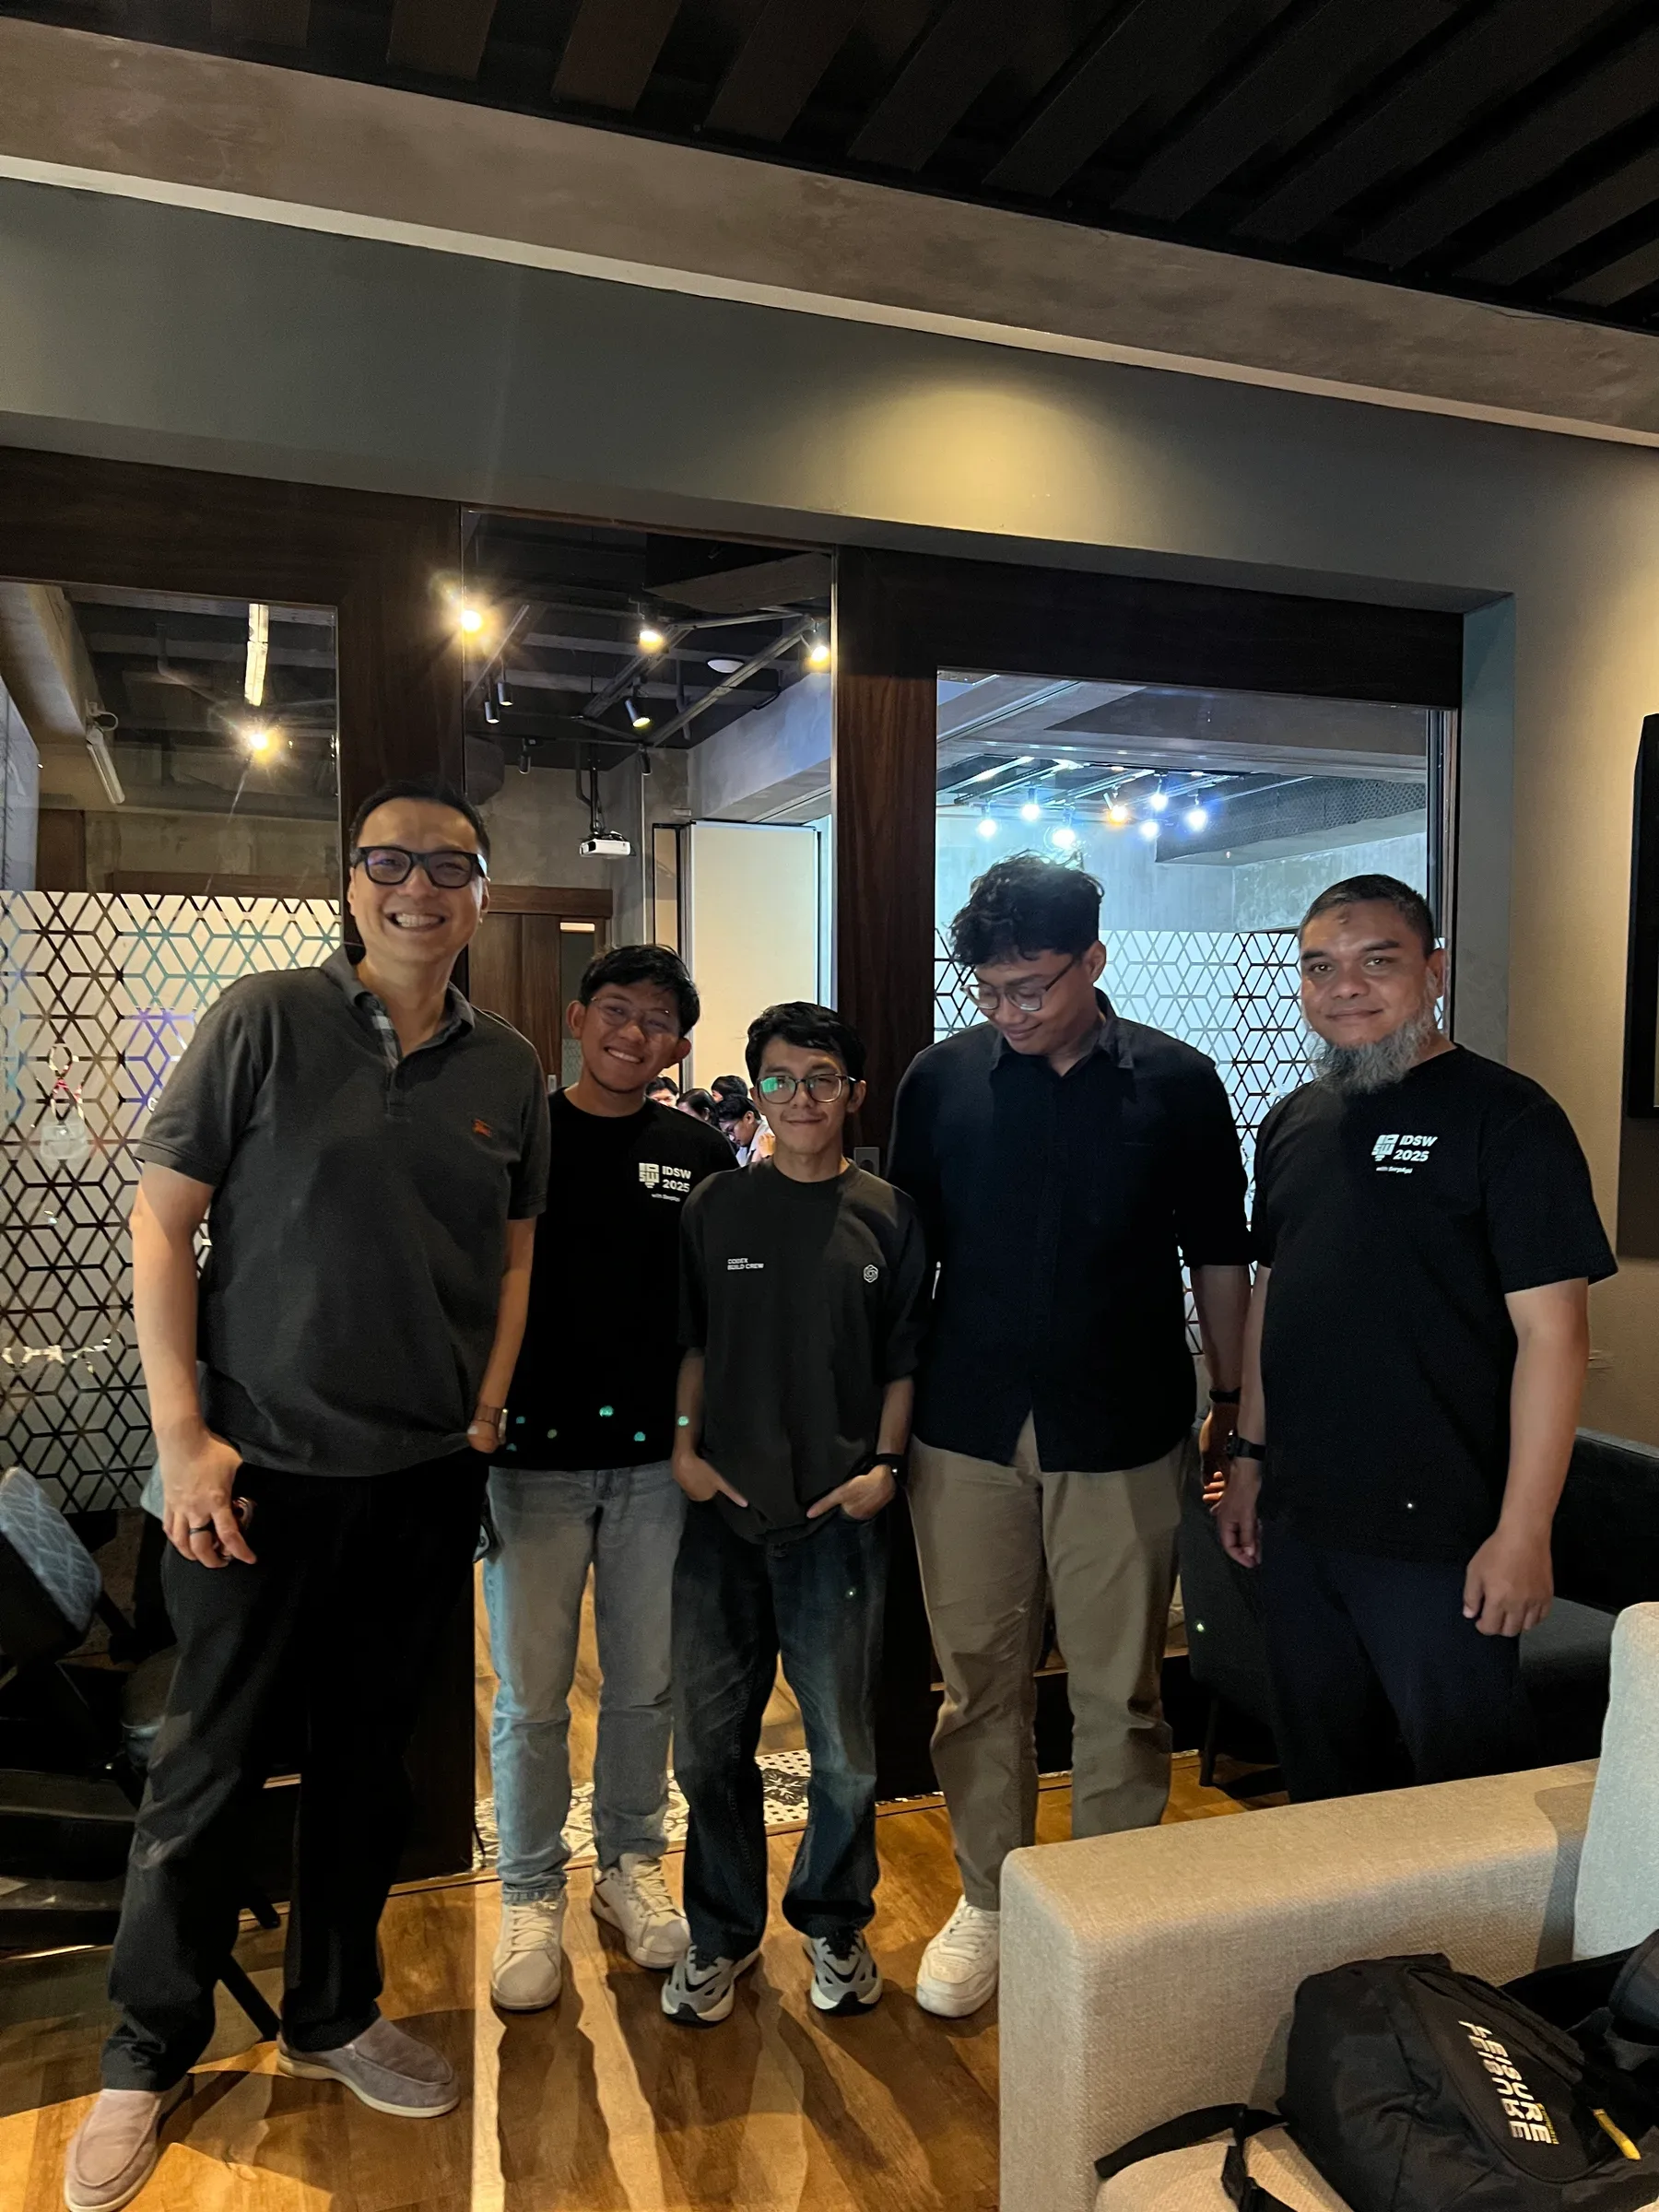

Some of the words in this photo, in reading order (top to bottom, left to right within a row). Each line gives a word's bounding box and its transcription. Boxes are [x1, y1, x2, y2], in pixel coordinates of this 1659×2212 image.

[1399, 1135, 1438, 1147] IDSW
[1393, 1149, 1430, 1162] 2025
[662, 1165, 691, 1180] IDSW
[662, 1179, 690, 1193] 2025
